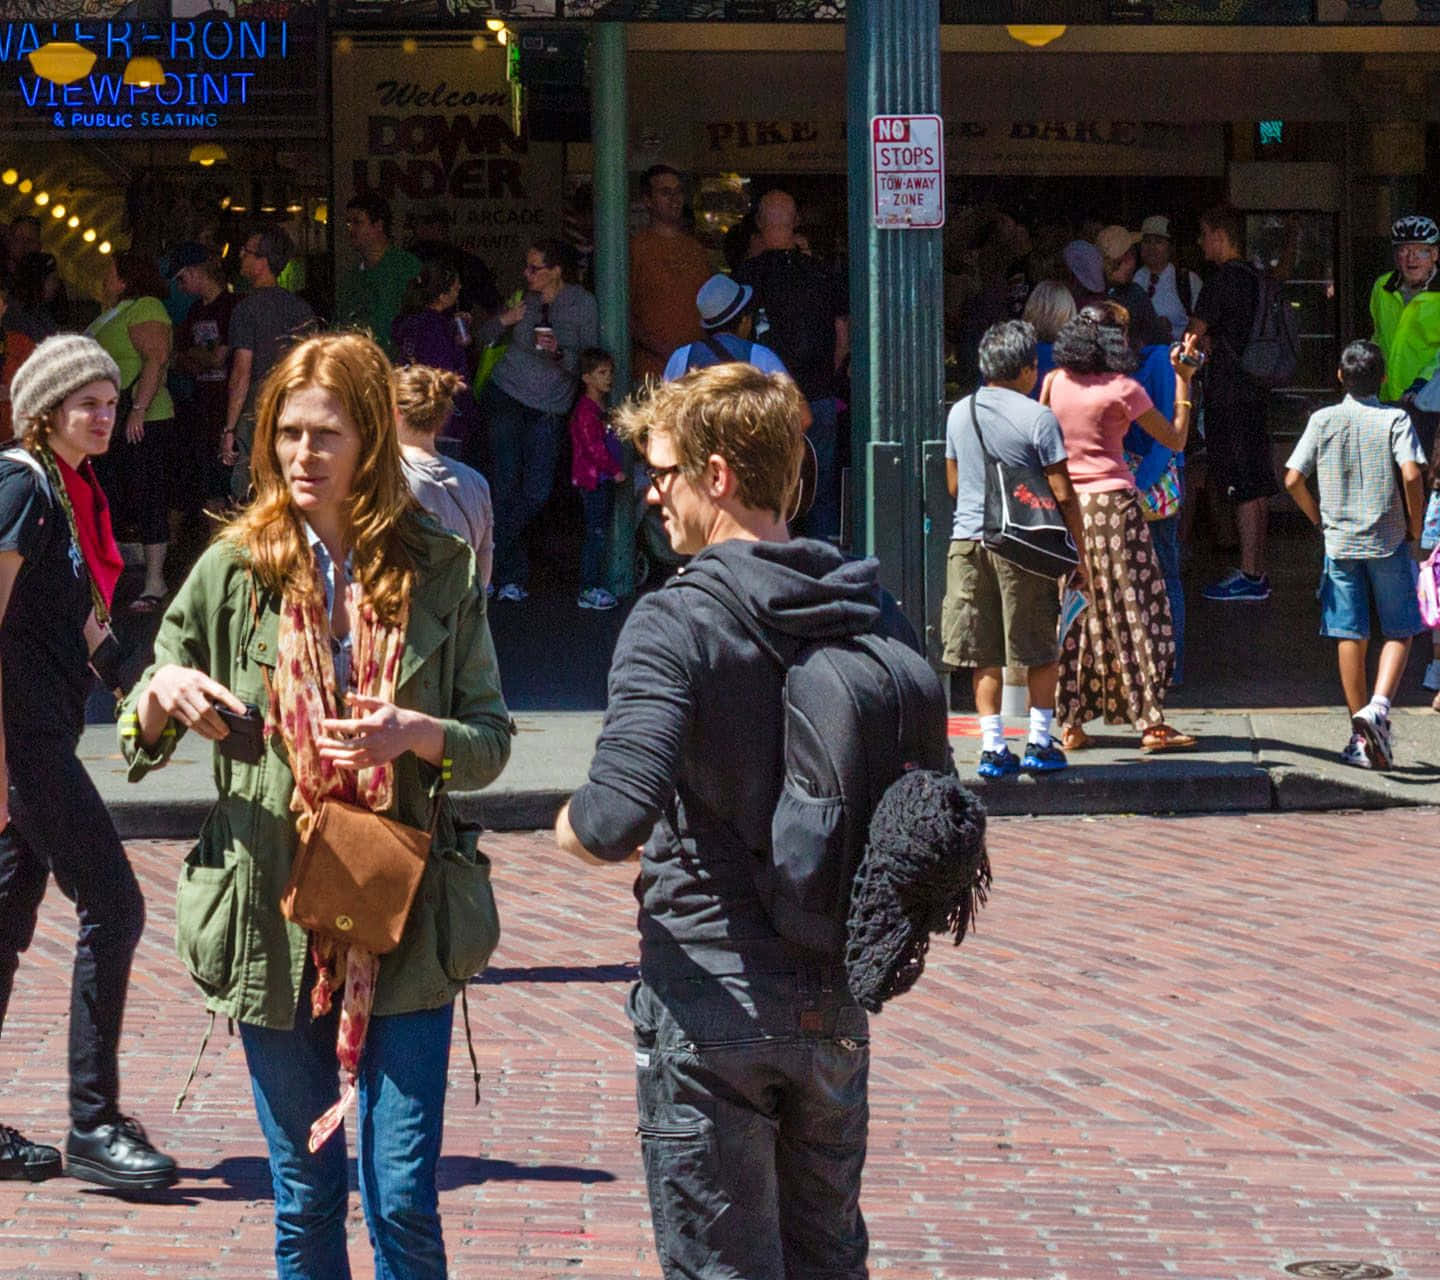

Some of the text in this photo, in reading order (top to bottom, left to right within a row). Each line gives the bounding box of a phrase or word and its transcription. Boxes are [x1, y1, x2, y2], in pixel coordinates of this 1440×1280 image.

[54, 112, 219, 129] & PUBLIC SEATING
[878, 119, 905, 140] NO
[368, 114, 528, 160] DOWN
[881, 147, 934, 167] STOPS
[352, 159, 528, 199] UNDER
[880, 177, 936, 190] TOW-AWAY
[893, 193, 925, 206] ZONE
[468, 208, 546, 227] ARCADE
